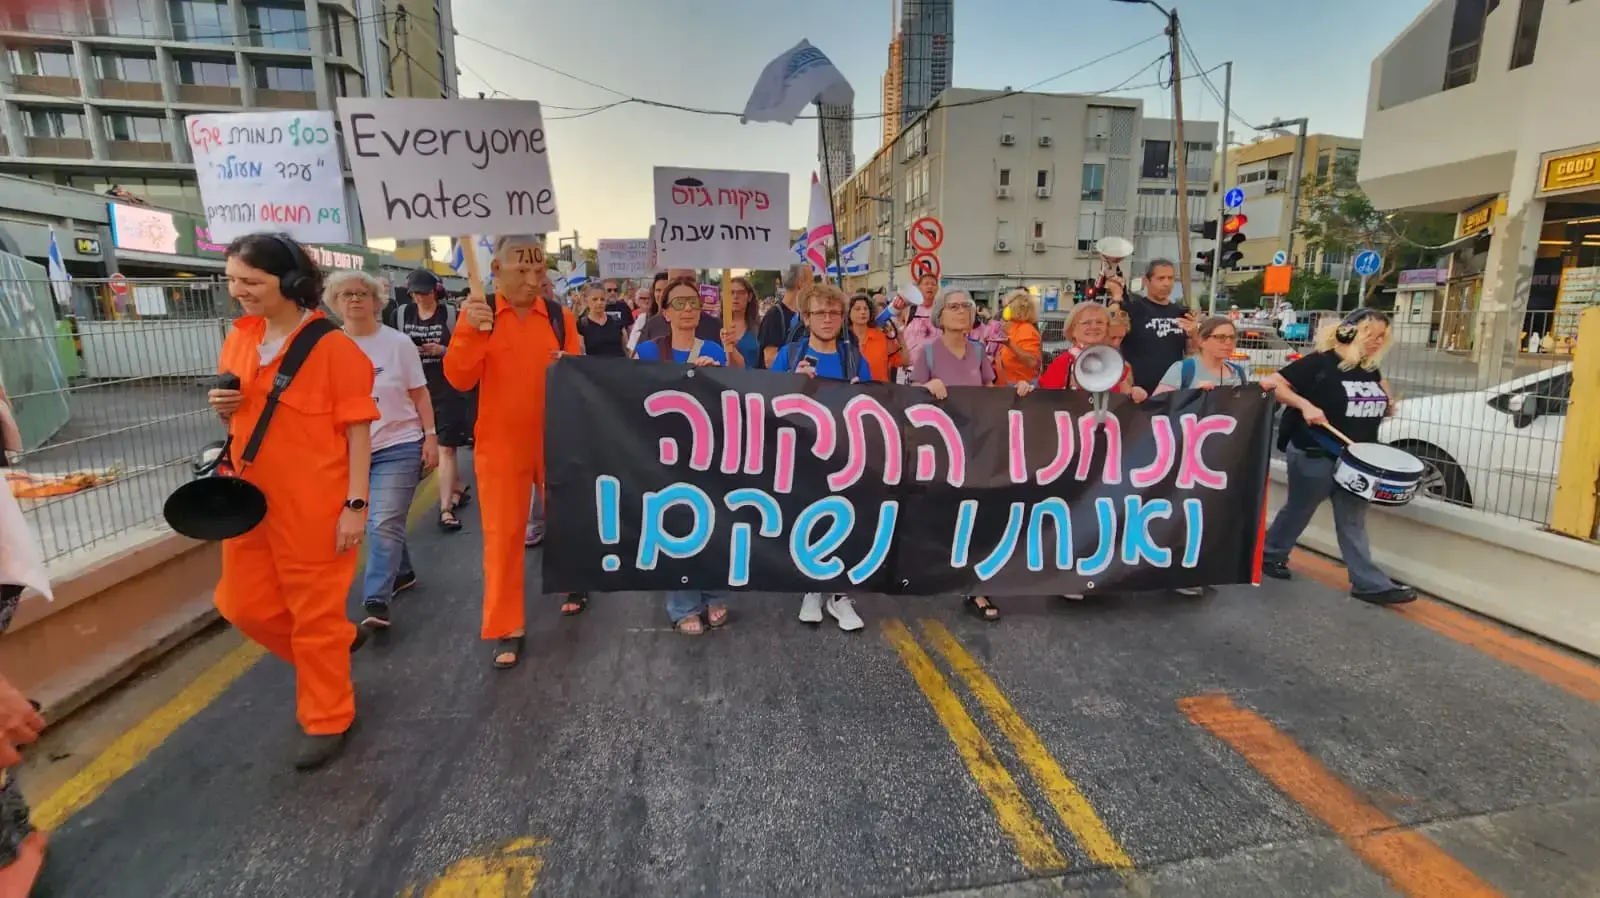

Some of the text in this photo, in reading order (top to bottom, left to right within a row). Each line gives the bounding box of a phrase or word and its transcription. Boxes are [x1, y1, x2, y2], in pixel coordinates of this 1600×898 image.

[191, 119, 223, 153] שקט
[228, 126, 283, 144] תמורת
[350, 113, 546, 170] Everyone
[260, 204, 311, 224] חמאס
[317, 207, 341, 224] עם
[381, 179, 555, 220] hates me
[718, 188, 770, 220] פיקוח
[658, 217, 771, 252] דוחה שבת?
[515, 248, 543, 264] 7.10
[644, 389, 1237, 493] אנחנו התקווה
[595, 474, 1204, 586] ואנחנו נשקם!
